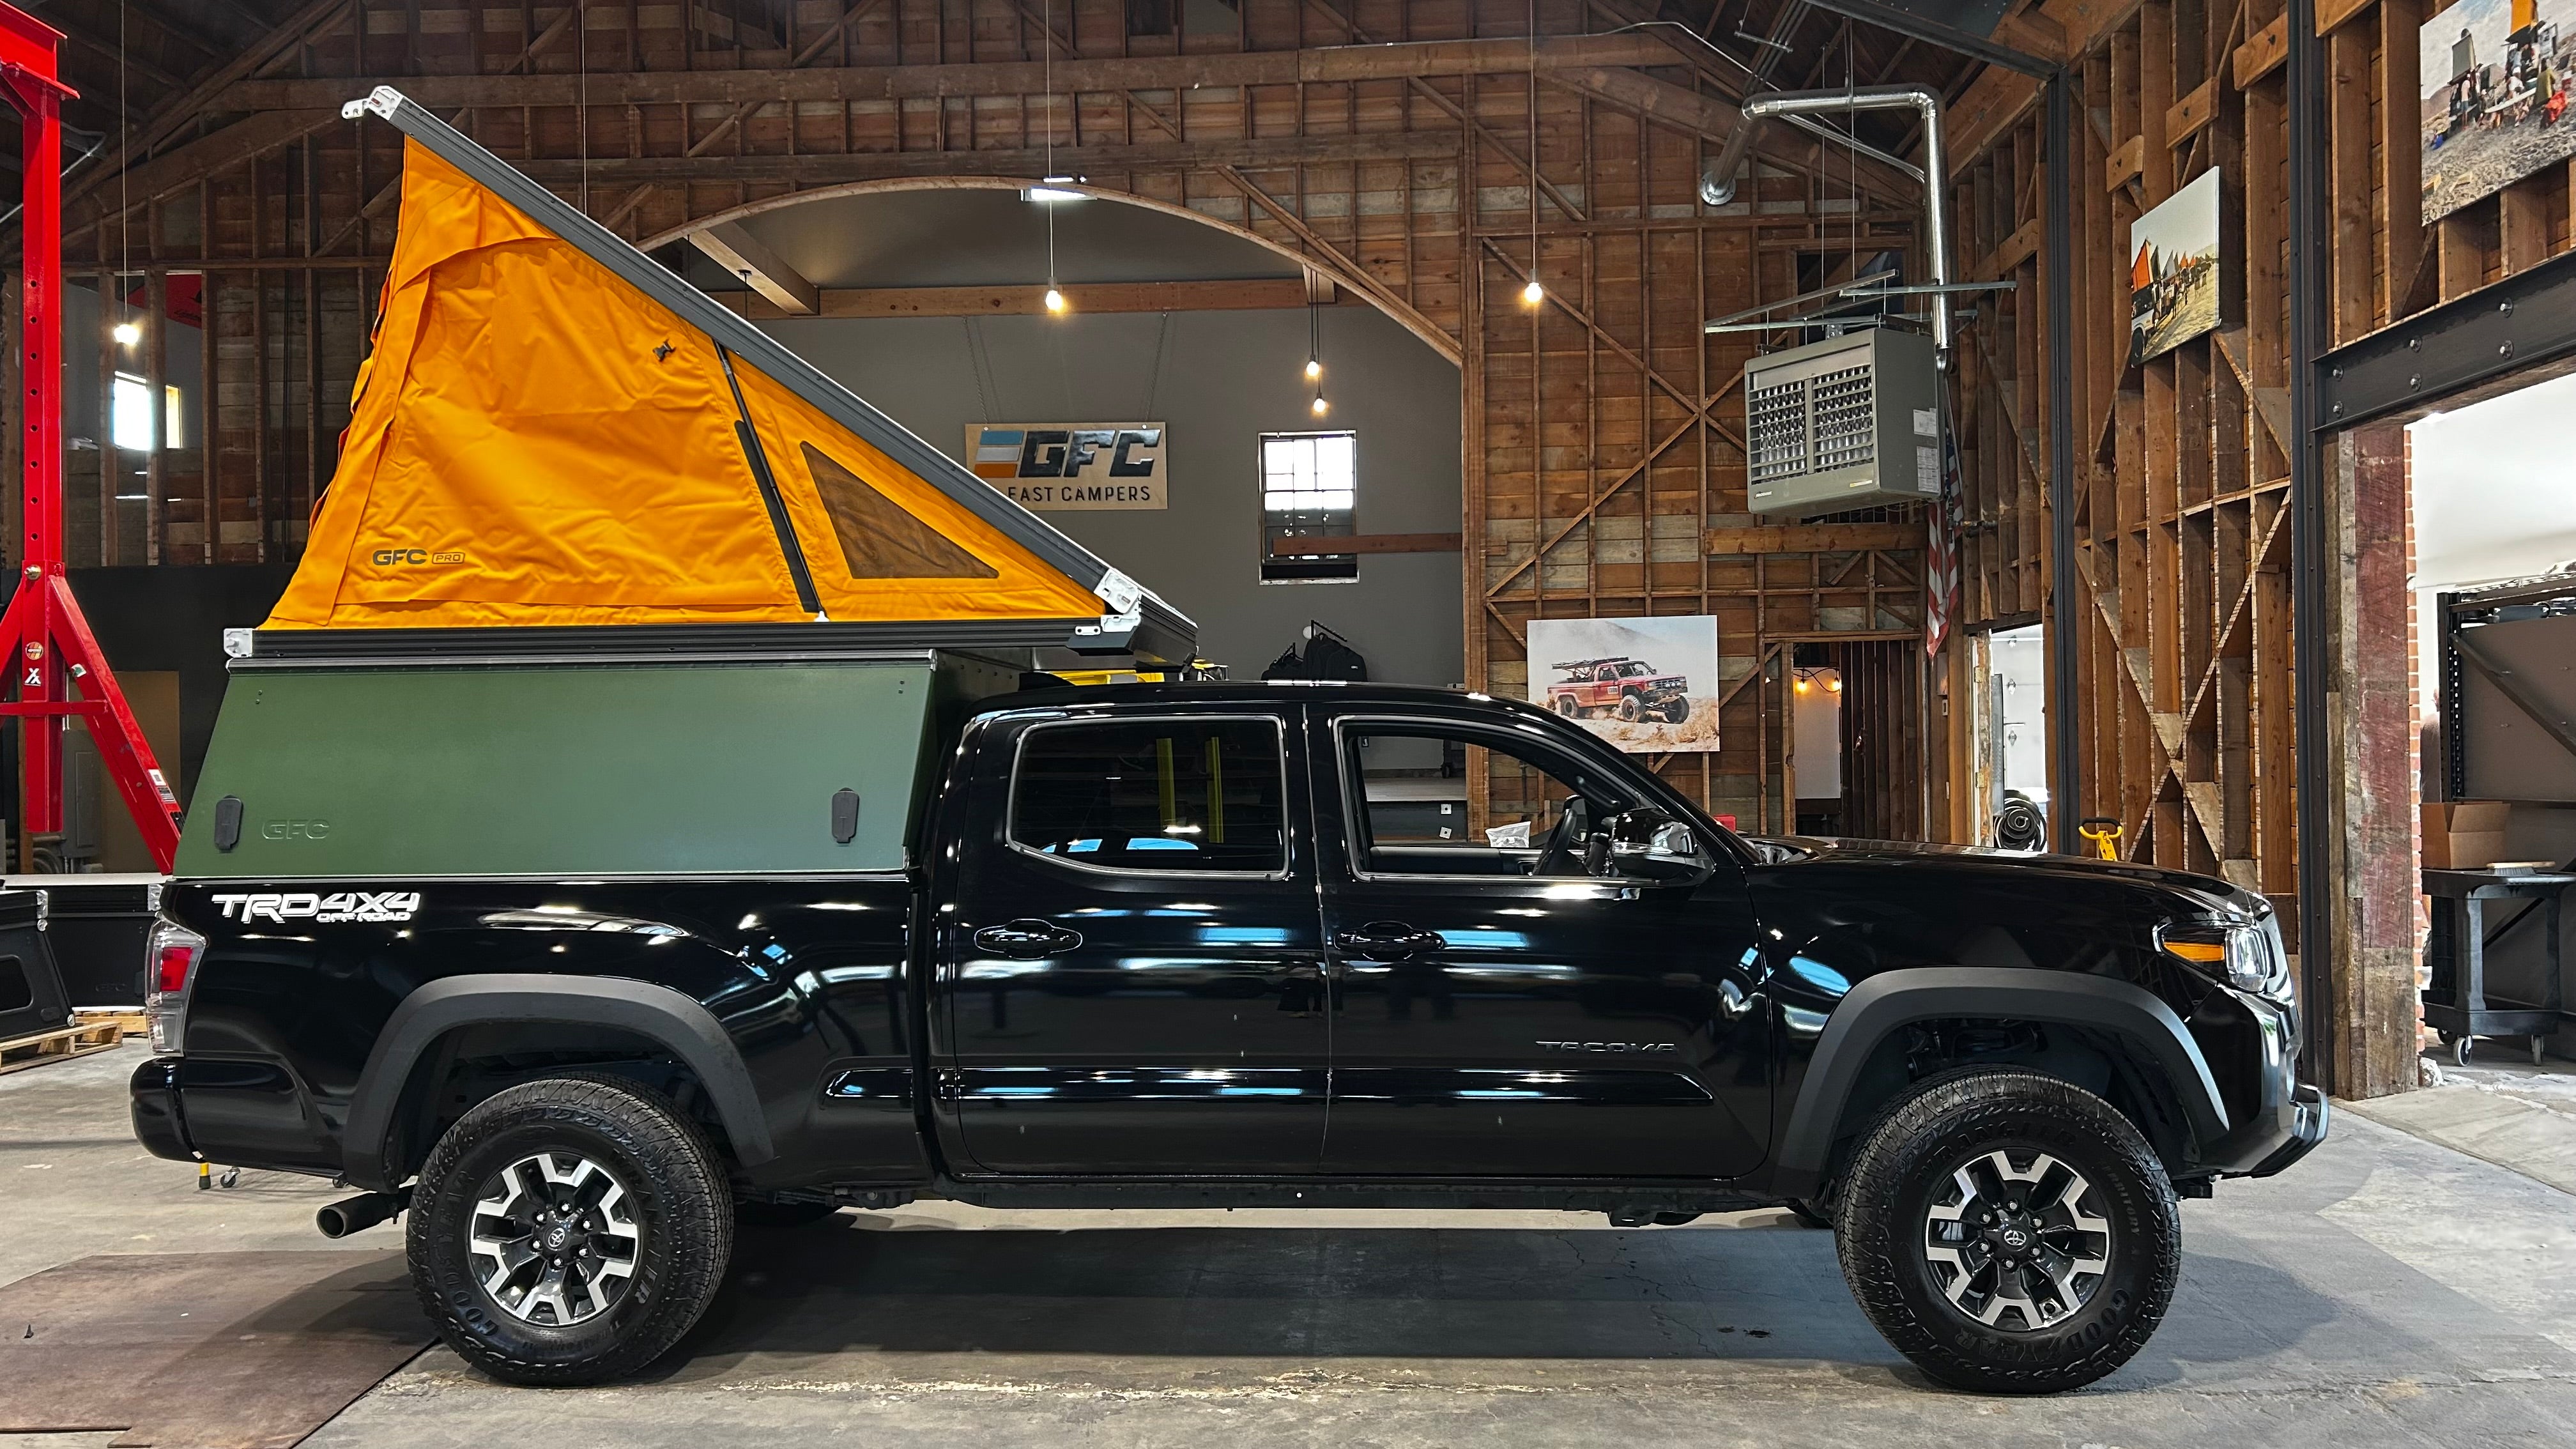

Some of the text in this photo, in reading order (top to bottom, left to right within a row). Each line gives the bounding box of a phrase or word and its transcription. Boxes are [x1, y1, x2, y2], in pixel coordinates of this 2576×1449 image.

[1019, 429, 1161, 477] GFC
[1061, 486, 1151, 502] CAMPERS
[373, 549, 461, 565] GFC PRO
[262, 818, 330, 839] GFC
[211, 893, 320, 924] TRD
[316, 912, 412, 923] OFF ROAD
[1535, 1040, 1678, 1054] TACOMA
